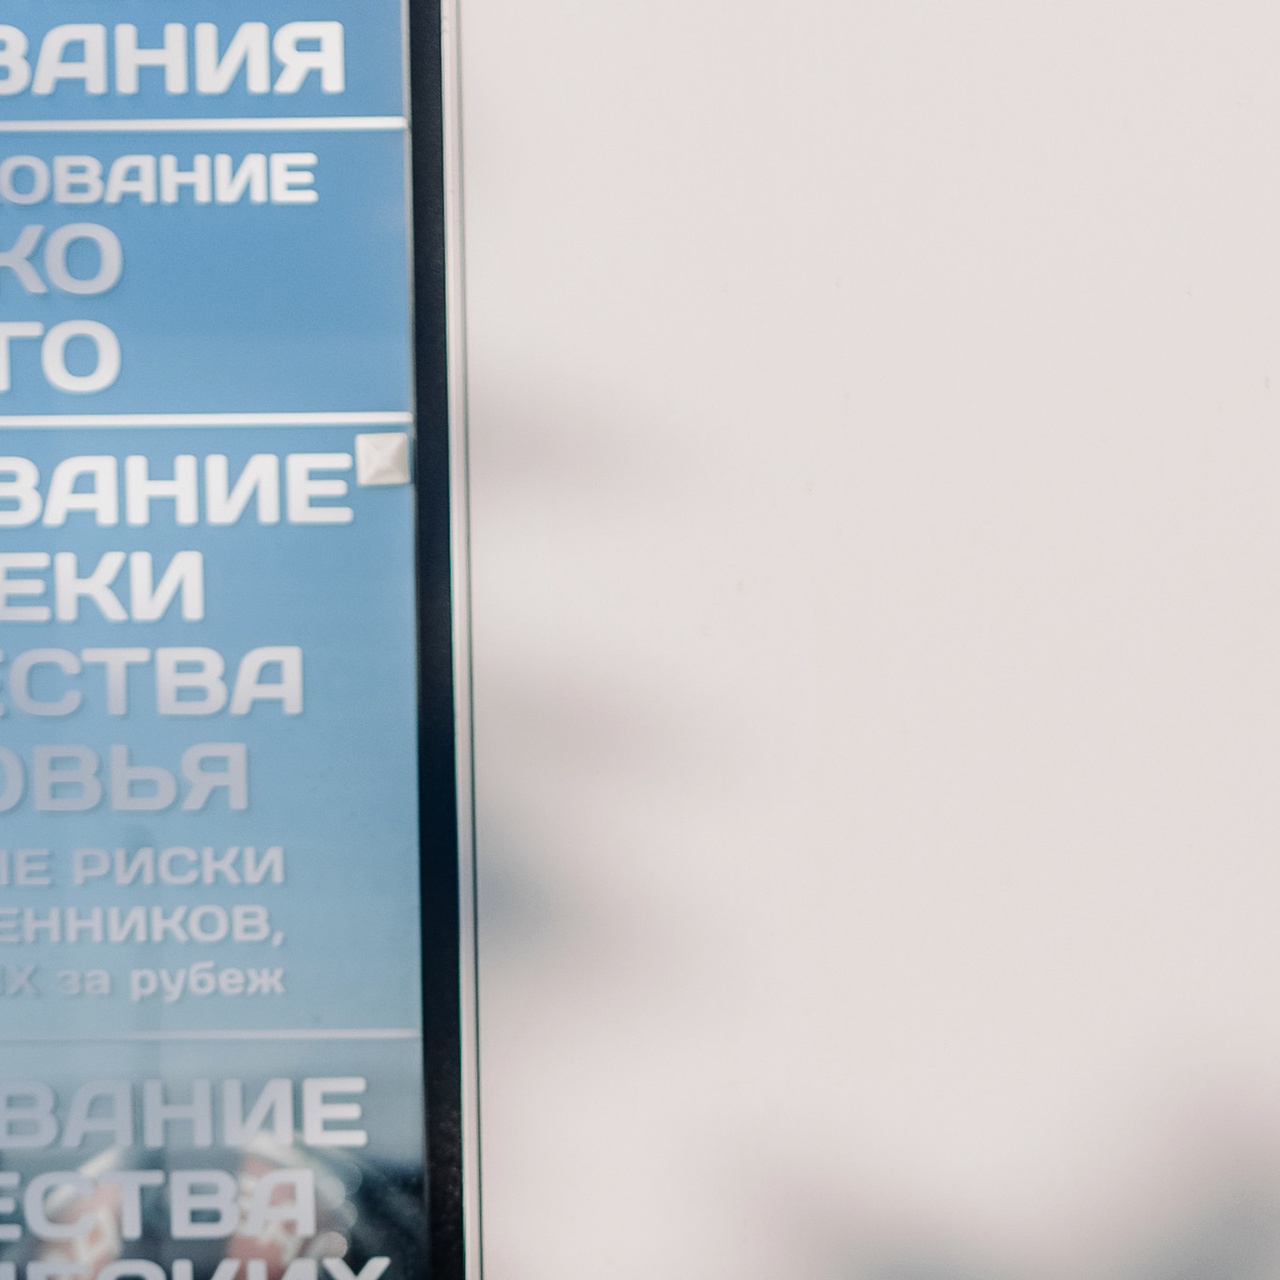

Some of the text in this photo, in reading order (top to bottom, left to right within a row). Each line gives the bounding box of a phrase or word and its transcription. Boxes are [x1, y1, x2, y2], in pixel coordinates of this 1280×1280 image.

[0, 151, 319, 204] ОВАНИЕ
[0, 452, 354, 526] ВАНИЕ
[0, 550, 204, 622] ЕКИ
[0, 645, 304, 716] СТВА
[0, 846, 285, 886] Е РИСКИ
[56, 968, 111, 995] за
[130, 960, 286, 1002] рубеж
[0, 1076, 369, 1149] ВАНИЕ
